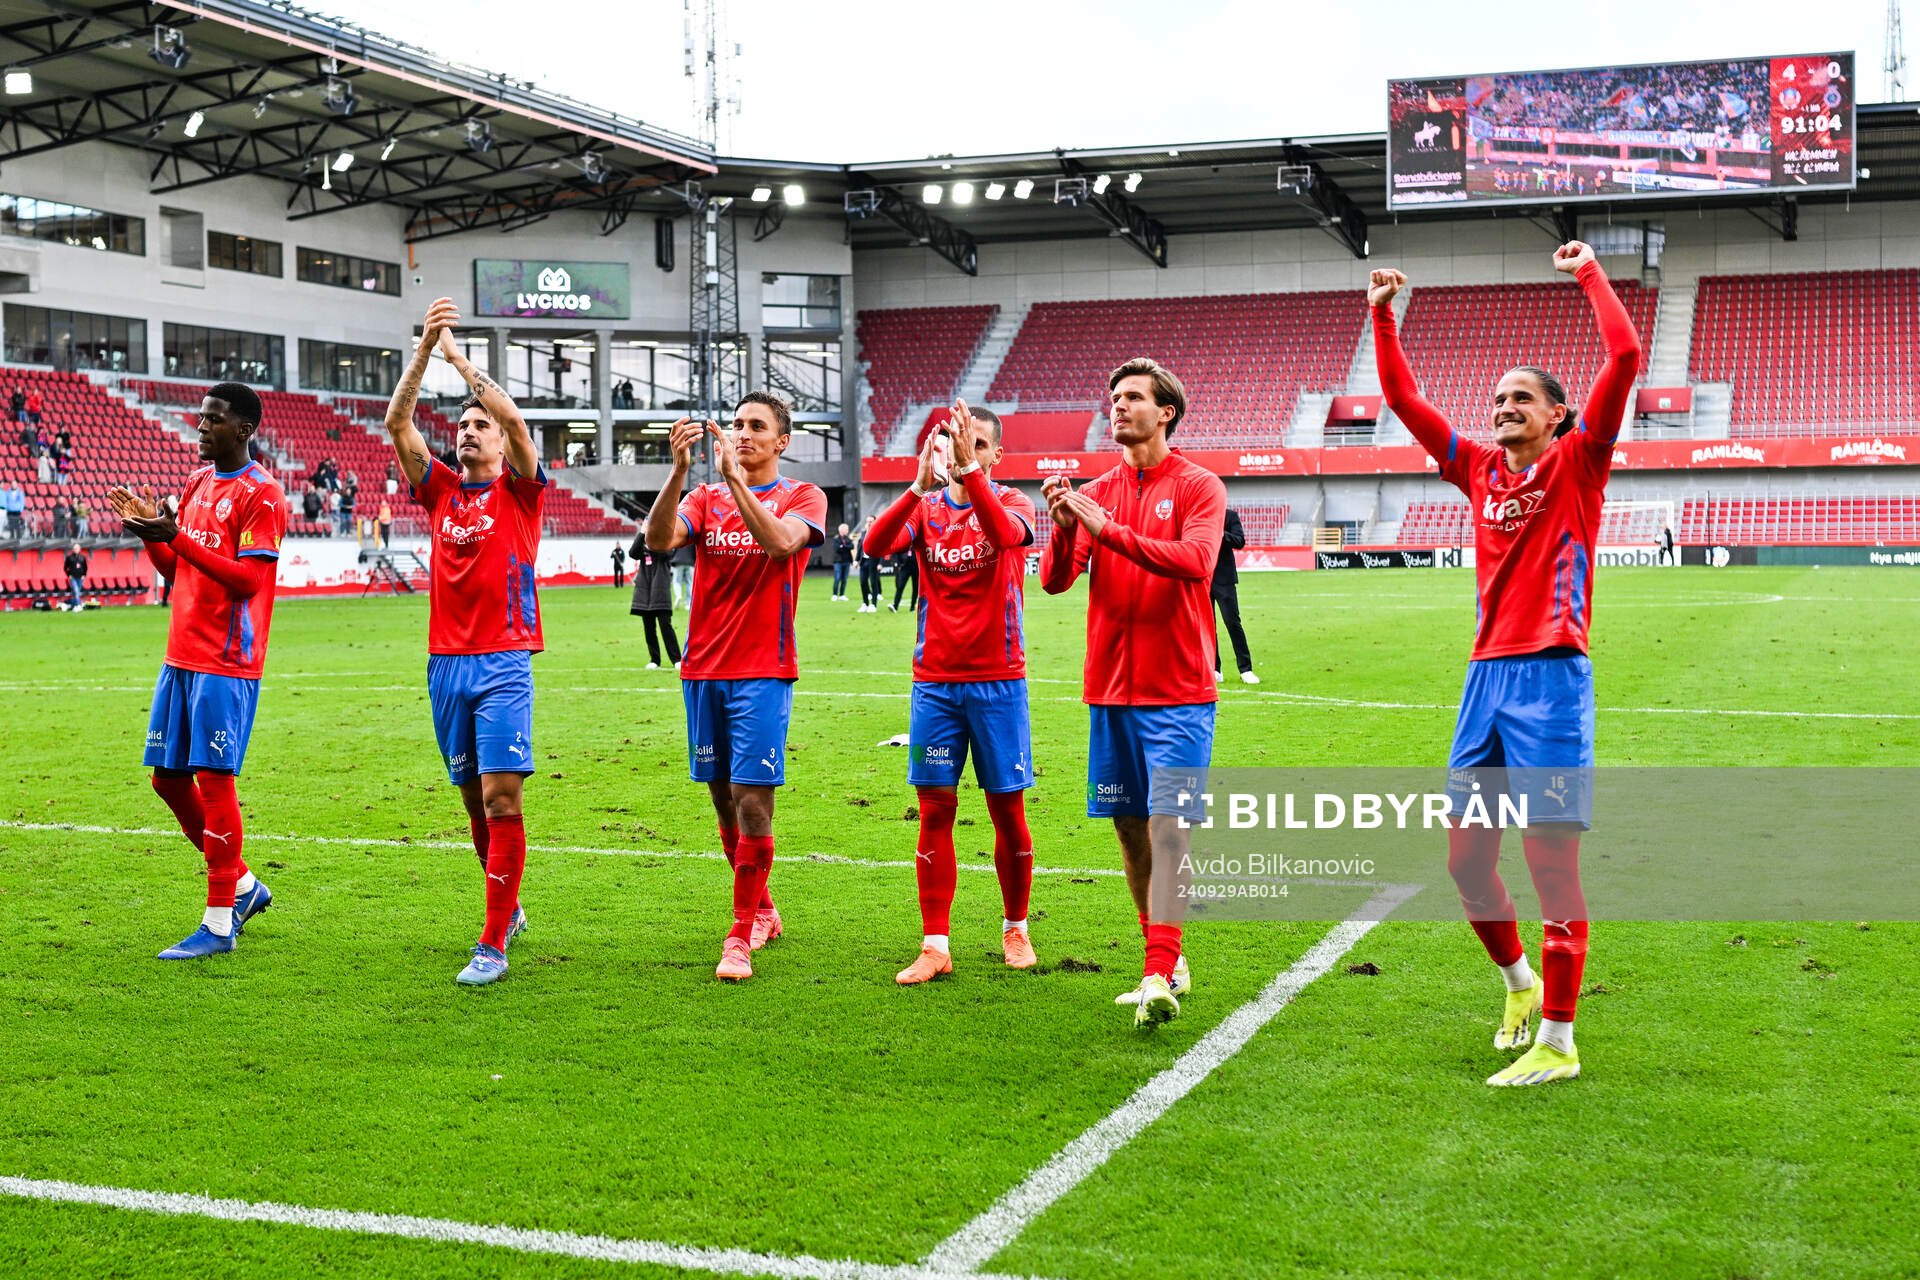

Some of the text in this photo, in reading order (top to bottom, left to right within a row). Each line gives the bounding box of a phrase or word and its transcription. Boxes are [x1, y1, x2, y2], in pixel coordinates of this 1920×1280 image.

[1783, 64, 1796, 80] 4
[1827, 62, 1840, 78] 0
[1781, 114, 1842, 133] 91:04
[517, 293, 591, 310] LYCKOS
[1691, 442, 1764, 463] RAMLÖSA
[1831, 439, 1906, 460] RAMLÖSA
[1037, 457, 1067, 469] akea
[1239, 453, 1272, 466] akea
[705, 526, 753, 547] akea
[926, 542, 975, 564] akea
[1597, 549, 1660, 567] mobi
[215, 730, 227, 742] 22
[516, 731, 522, 742] 2
[695, 744, 714, 755] Solid
[769, 747, 776, 759] 3
[926, 746, 949, 757] Solid
[1187, 776, 1198, 789] 13
[1449, 768, 1476, 784] Solid
[1550, 775, 1565, 789] 16
[1097, 783, 1123, 795] Solid
